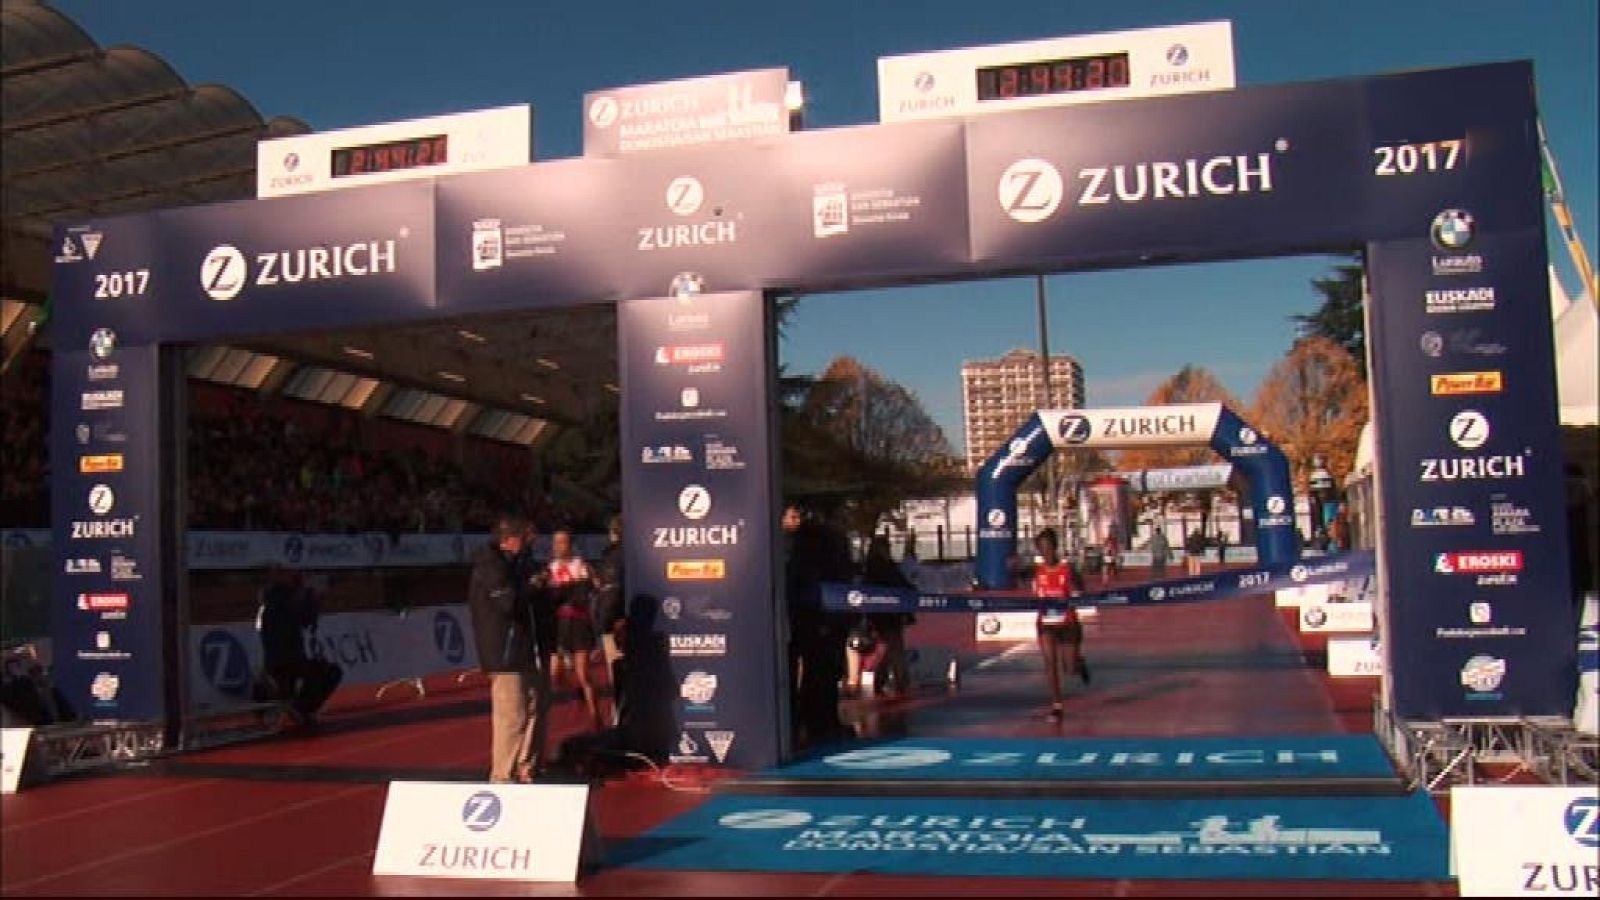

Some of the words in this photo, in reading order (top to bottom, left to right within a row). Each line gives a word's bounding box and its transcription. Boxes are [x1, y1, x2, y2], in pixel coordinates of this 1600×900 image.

[1150, 70, 1211, 87] ZURICH
[899, 96, 956, 113] ZURICH
[1374, 140, 1464, 176] 2017
[1077, 152, 1274, 205] ZURICH
[637, 219, 737, 251] ZURICH
[255, 239, 397, 286] ZURICH
[94, 268, 150, 299] 2017
[1425, 287, 1495, 304] EUSKADI
[1102, 414, 1196, 438] ZURICH
[1420, 454, 1526, 482] ZURICH
[70, 519, 135, 539] ZURICH
[652, 524, 739, 549] ZURICH
[1238, 571, 1271, 589] 2017
[965, 750, 1338, 765] ZURICH
[815, 815, 1086, 829] ZURICH
[418, 842, 532, 870] ZURICH
